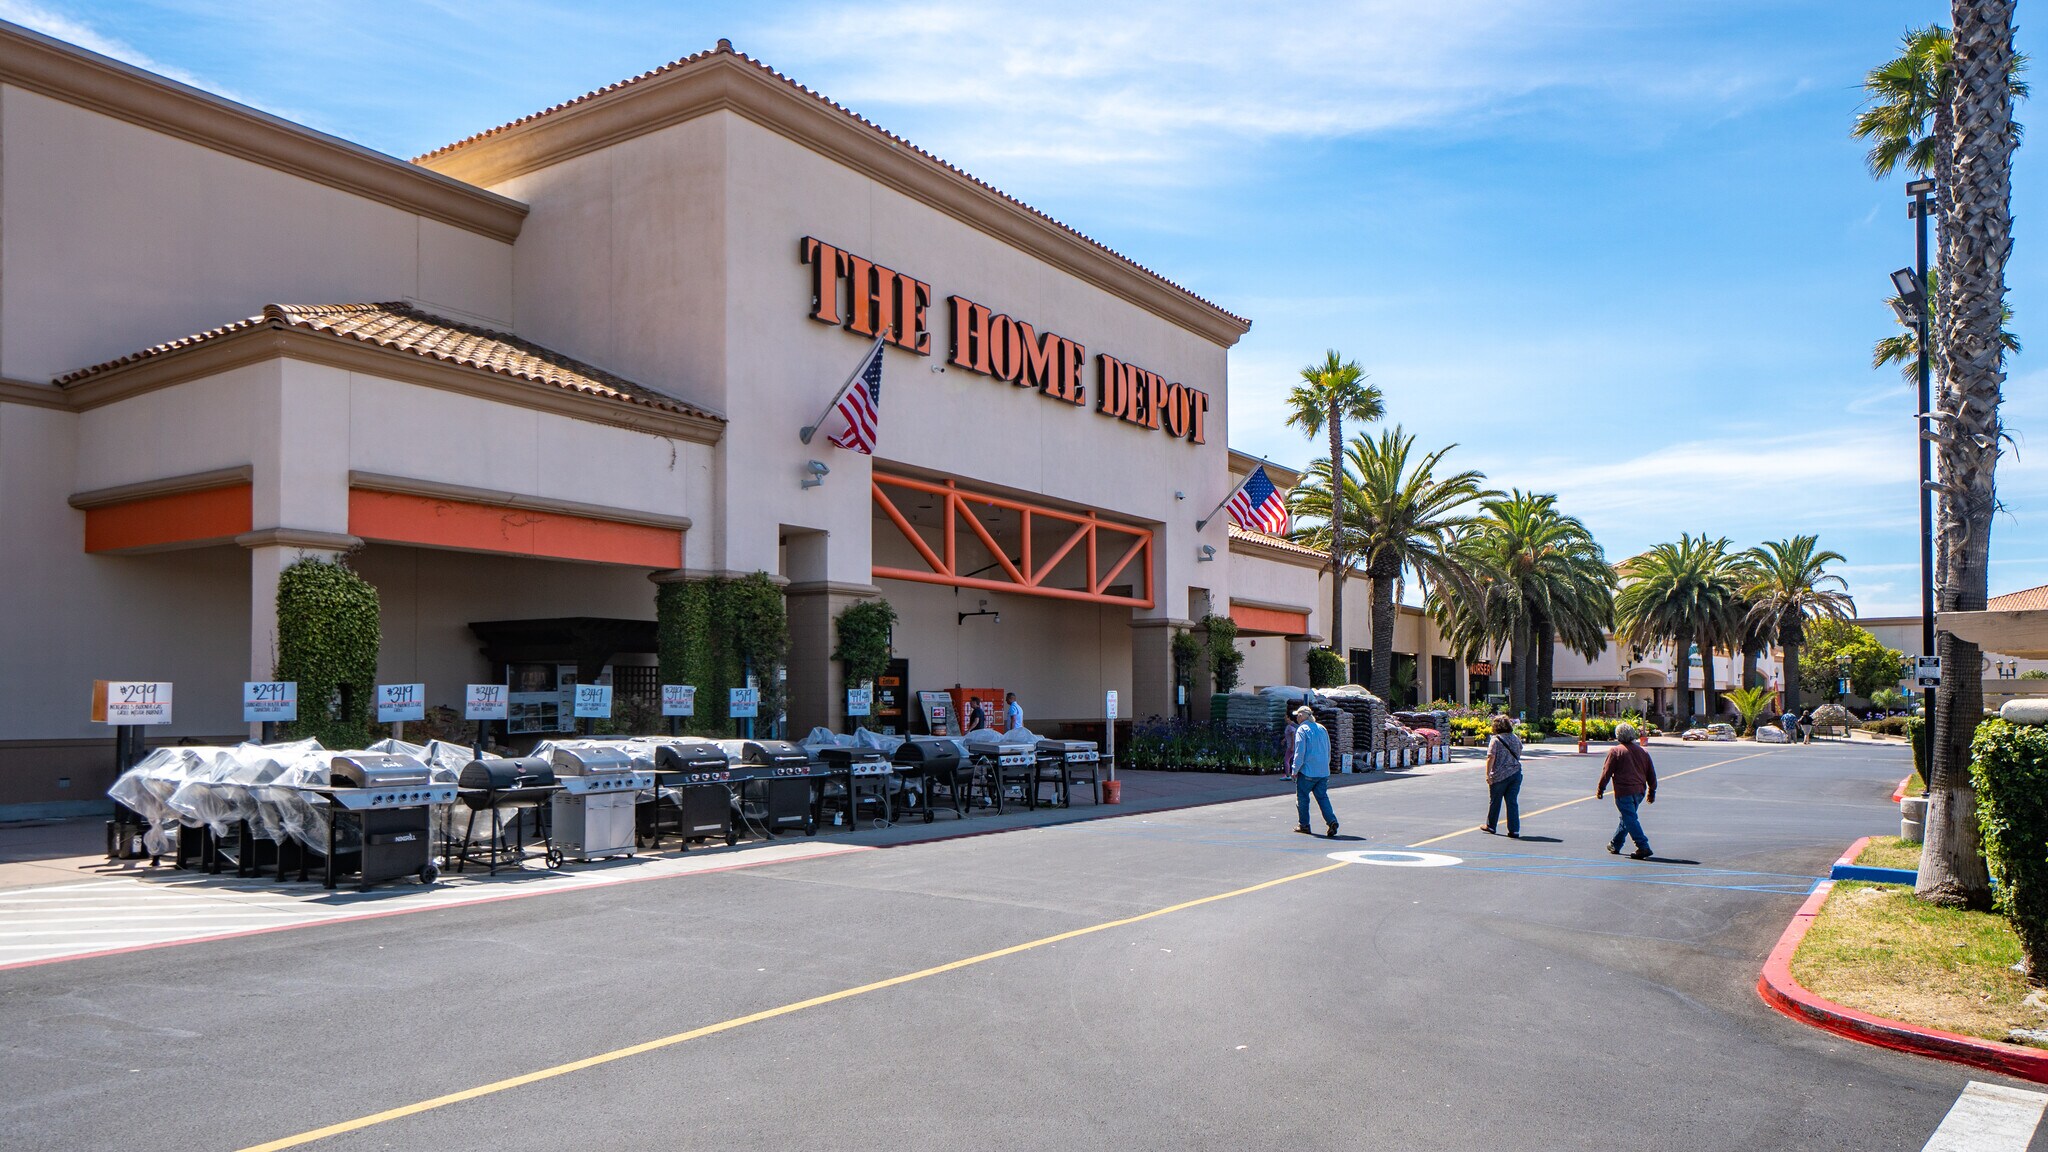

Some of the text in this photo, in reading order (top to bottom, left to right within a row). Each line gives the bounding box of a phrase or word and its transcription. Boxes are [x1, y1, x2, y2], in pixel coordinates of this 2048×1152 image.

[801, 235, 1210, 446] THE HOME DEPOT
[120, 683, 158, 704] $299
[253, 682, 286, 701] $299
[386, 685, 414, 703] $349
[475, 686, 500, 703] $349
[580, 687, 604, 703] $349
[964, 701, 994, 716] OER
